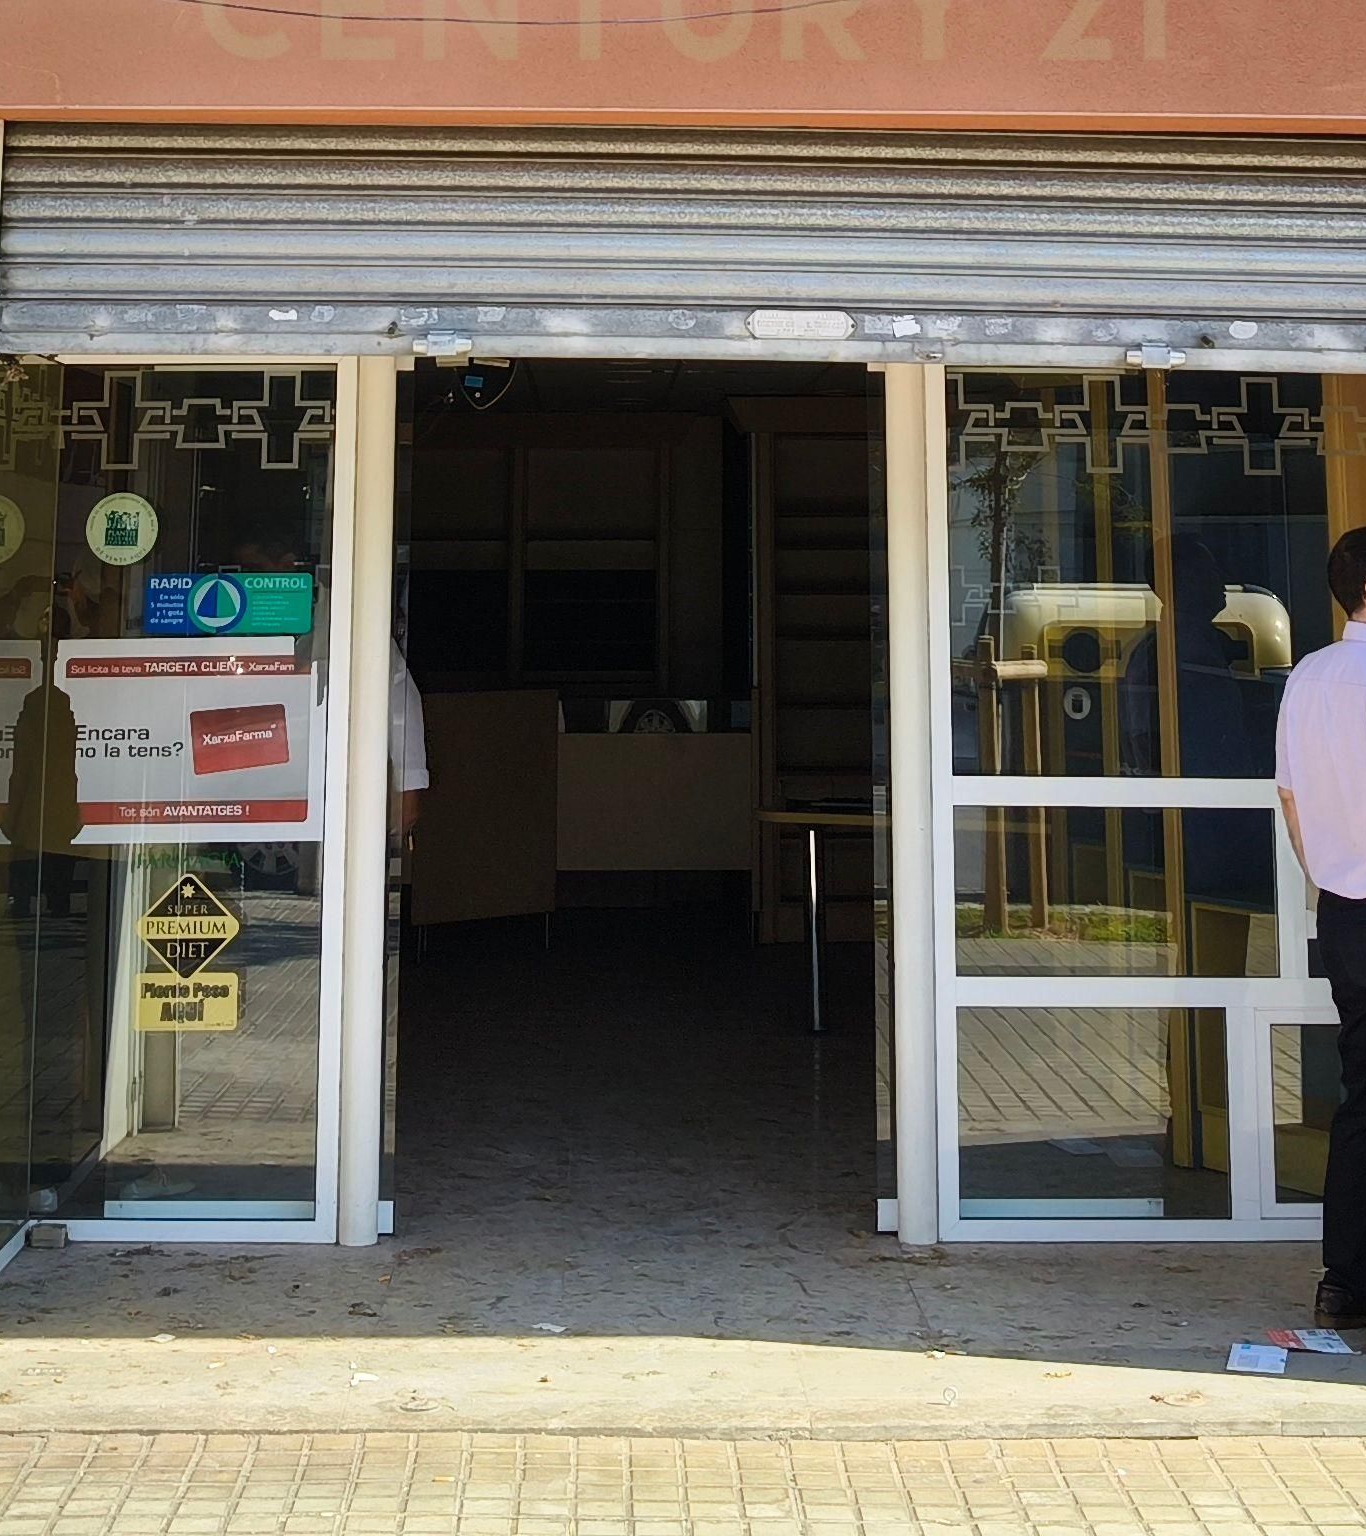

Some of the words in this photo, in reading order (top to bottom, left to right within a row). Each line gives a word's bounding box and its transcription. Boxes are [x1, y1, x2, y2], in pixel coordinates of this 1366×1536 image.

[244, 577, 308, 589] CONTROL
[144, 662, 197, 672] TARGETA
[201, 661, 244, 672] CLIENT
[75, 724, 150, 741] Encara
[202, 729, 273, 746] XarxaFarma
[104, 742, 120, 758] la
[128, 741, 184, 758] tens?
[119, 806, 137, 818] Tot
[139, 805, 161, 818] són
[163, 805, 243, 817] AVANTATGES
[167, 904, 209, 915] SUPER
[146, 920, 228, 936] PREMIUM
[166, 941, 210, 959] DIET
[159, 997, 206, 1024] AQUÍ
